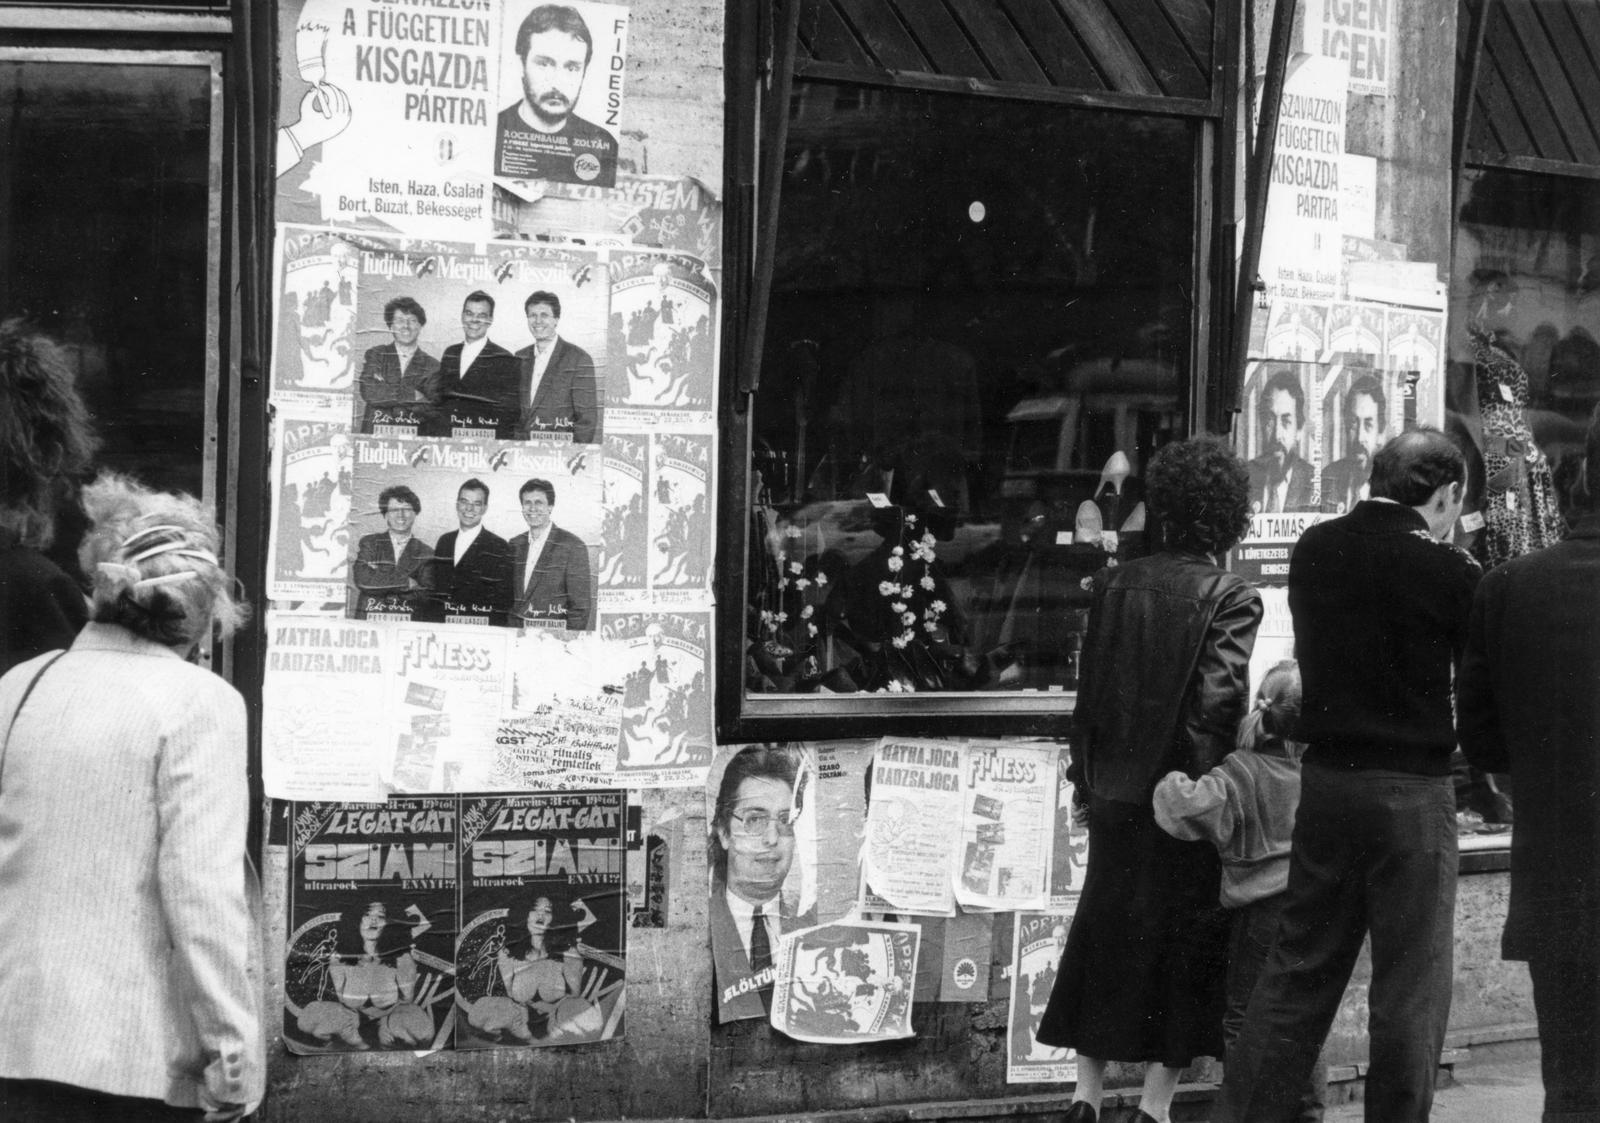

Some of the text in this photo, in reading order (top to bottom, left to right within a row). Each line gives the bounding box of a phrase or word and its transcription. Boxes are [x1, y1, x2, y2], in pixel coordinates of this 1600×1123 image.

[343, 6, 489, 47] A FÜGGETLEN
[356, 45, 489, 91] KISGAZDA
[605, 19, 626, 126] FIDESZ
[405, 88, 487, 126] PÁRTRA
[1281, 93, 1341, 125] SZAVAZZON
[1272, 153, 1338, 191] KISGAZDA
[360, 251, 413, 280] Tudjuk
[437, 255, 493, 285] Merjük
[356, 440, 408, 469] Tudjuk
[431, 444, 489, 472] Merjük
[304, 881, 358, 891] ultrarock
[473, 876, 525, 887] ultrarock
